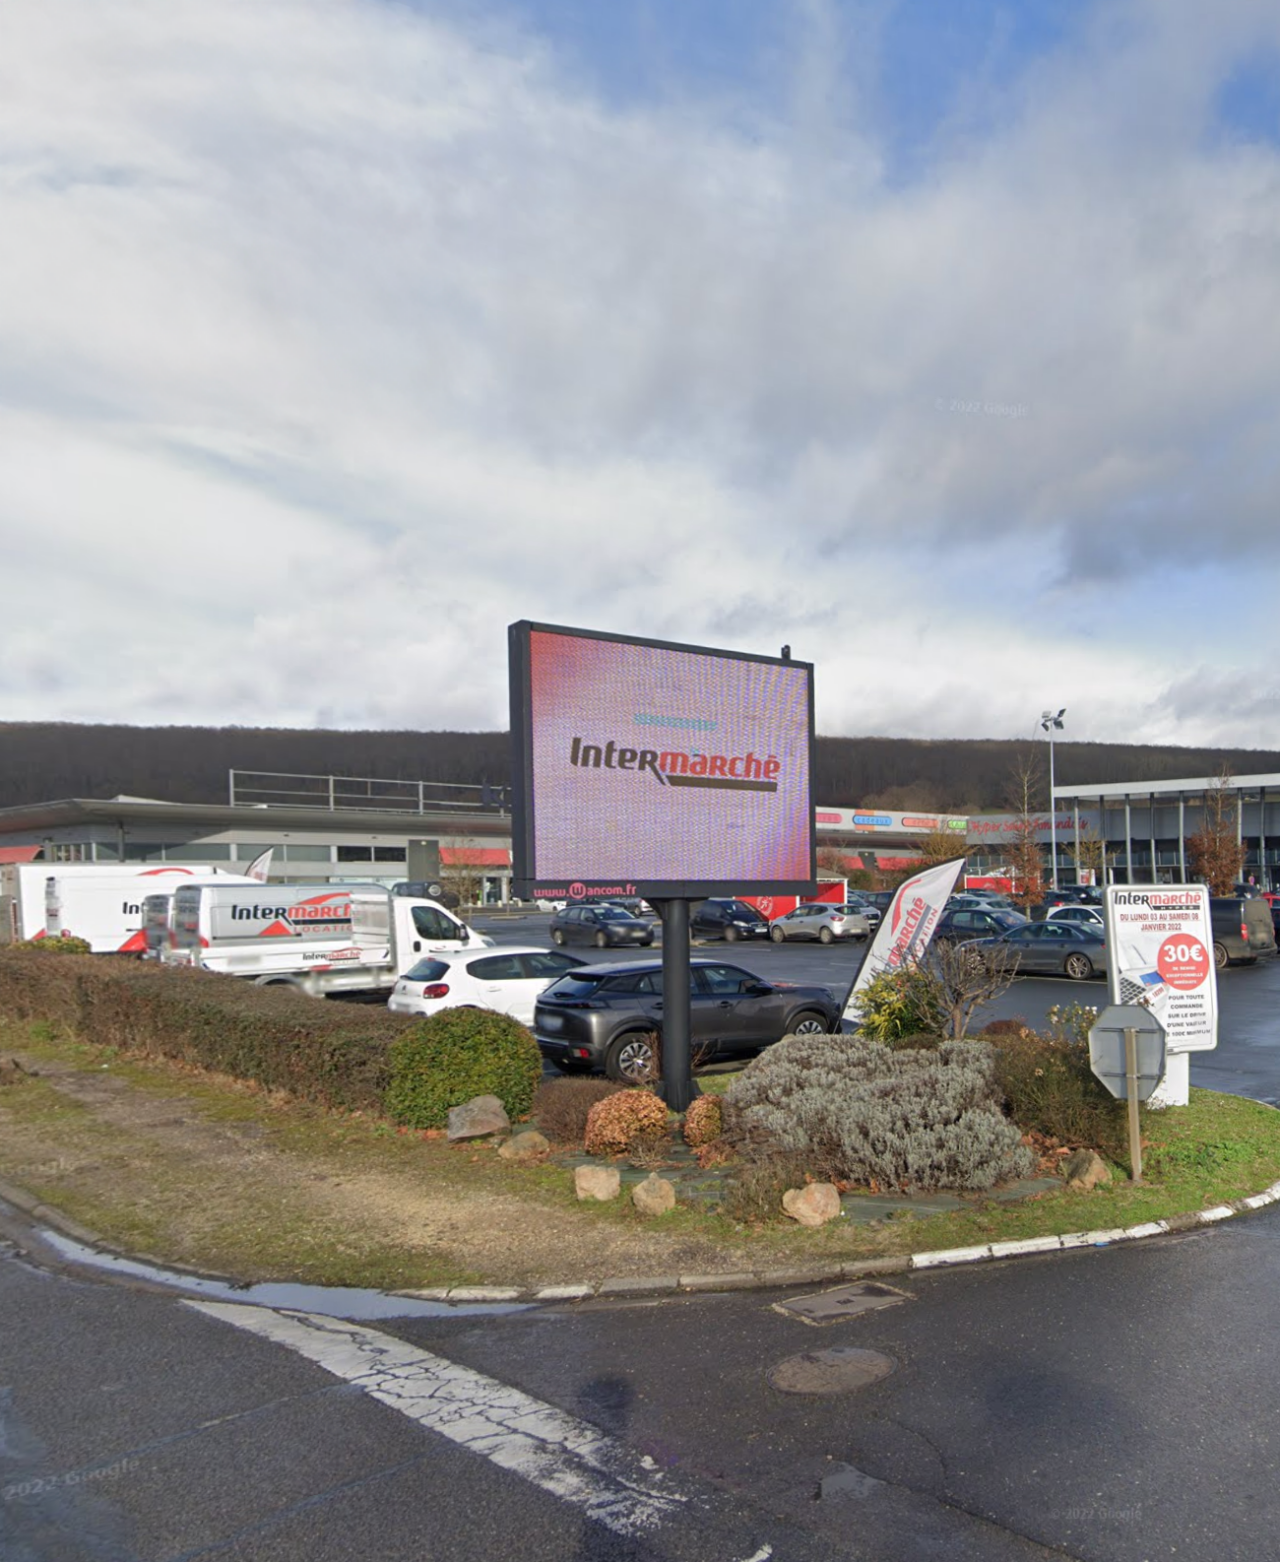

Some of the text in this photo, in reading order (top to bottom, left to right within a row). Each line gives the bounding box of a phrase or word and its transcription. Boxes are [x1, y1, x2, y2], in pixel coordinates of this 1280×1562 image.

[1120, 913, 1129, 921] DU
[1130, 913, 1149, 921] LUNDI
[1150, 913, 1158, 921] 03
[1159, 913, 1168, 921] AU
[1168, 912, 1191, 921] SAMEDI
[1141, 922, 1182, 931] JANVIER 2022
[1164, 944, 1203, 963] 30€
